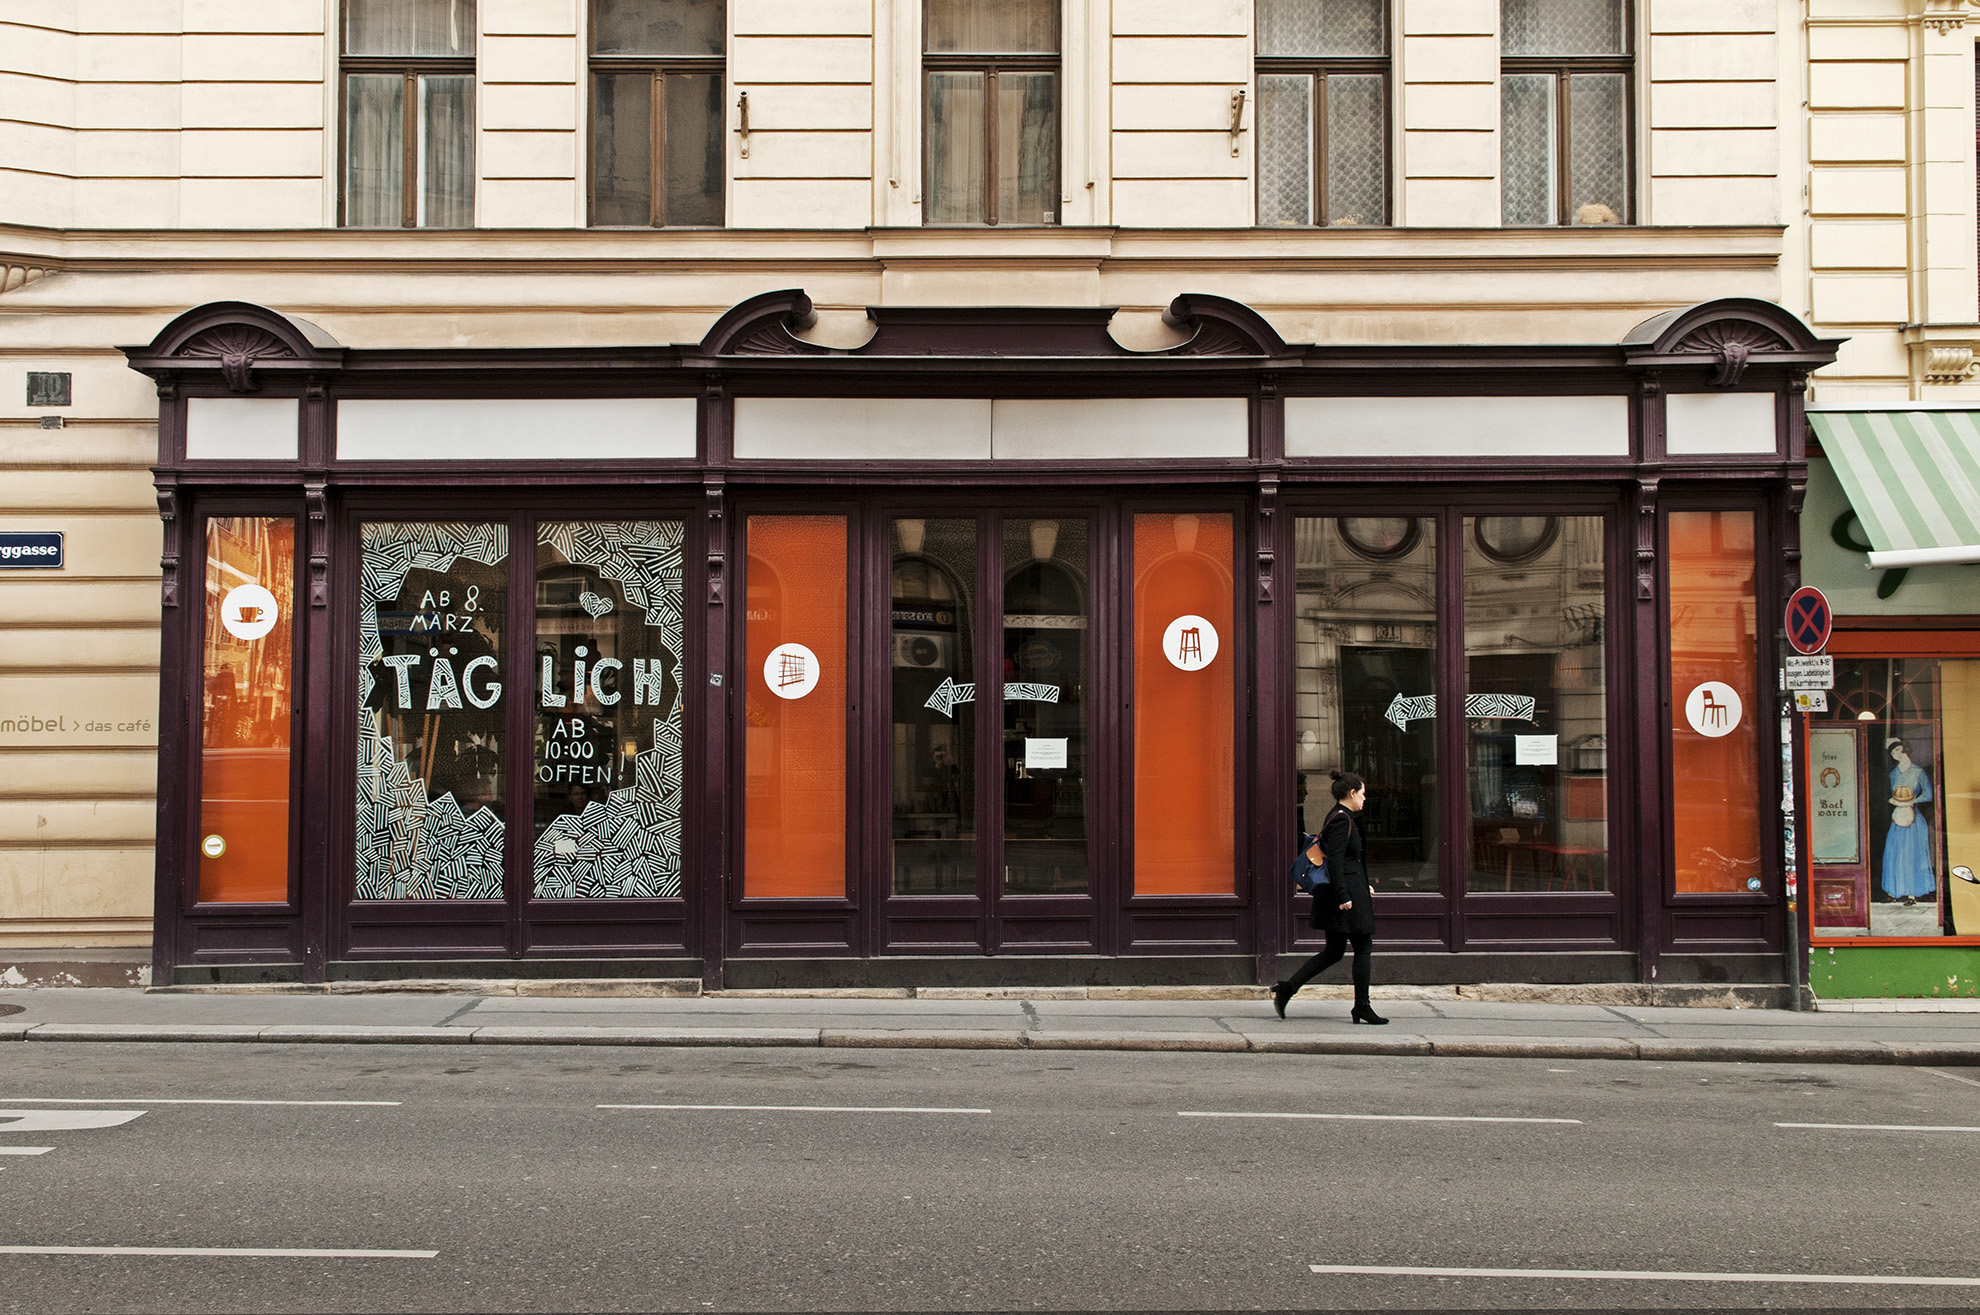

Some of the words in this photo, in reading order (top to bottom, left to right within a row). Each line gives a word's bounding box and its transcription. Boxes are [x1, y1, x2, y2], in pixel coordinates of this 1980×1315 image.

[0, 544, 58, 560] ggasse
[420, 589, 450, 609] AB
[464, 585, 485, 612] 8.
[409, 611, 474, 633] MÄRZ
[382, 646, 502, 711] TÄG
[0, 715, 66, 732] möbel
[85, 720, 112, 732] das
[117, 719, 151, 732] café
[552, 718, 586, 738] AB
[545, 740, 594, 760] 10:00
[1818, 810, 1848, 818] waren
[1819, 799, 1844, 809] Back
